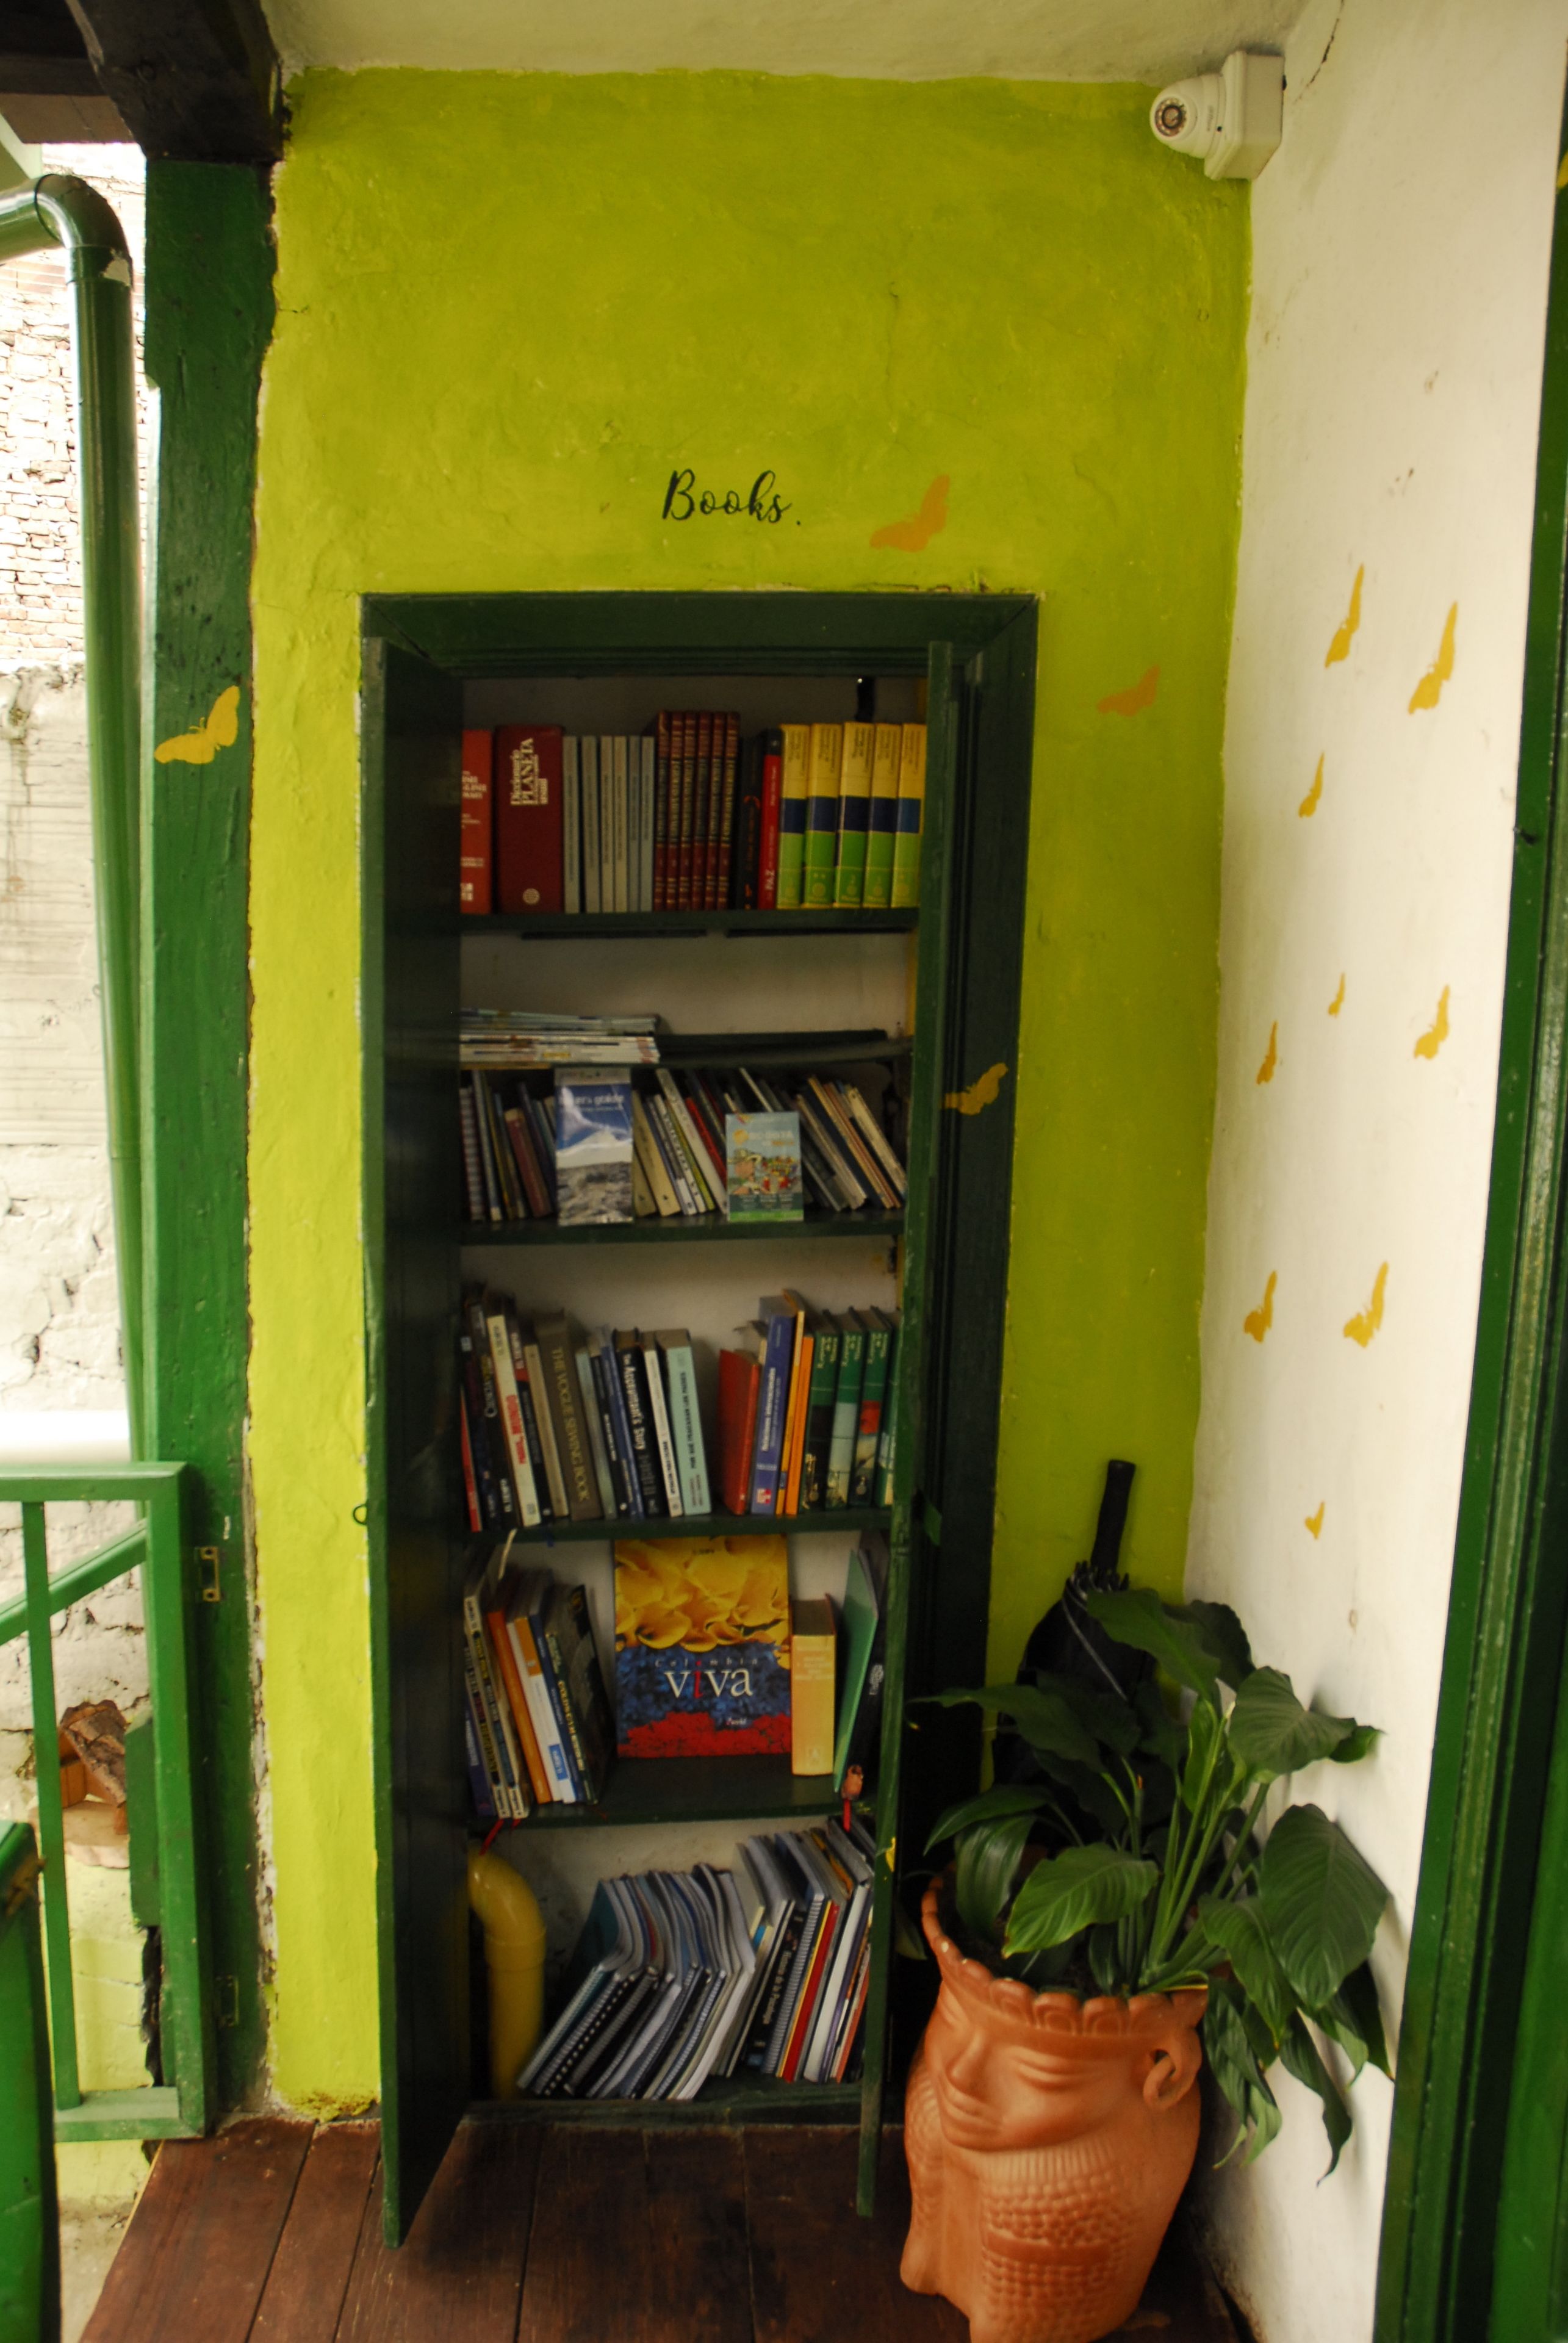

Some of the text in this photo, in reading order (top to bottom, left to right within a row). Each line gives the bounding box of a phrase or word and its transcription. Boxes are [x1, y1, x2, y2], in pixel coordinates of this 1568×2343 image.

[520, 738, 534, 805] PLANETA
[624, 1367, 643, 1423] Accountant's
[552, 1348, 589, 1502] THE VOGUE SEWING BOOK
[633, 1428, 647, 1449] Story
[663, 1660, 754, 1699] viva
